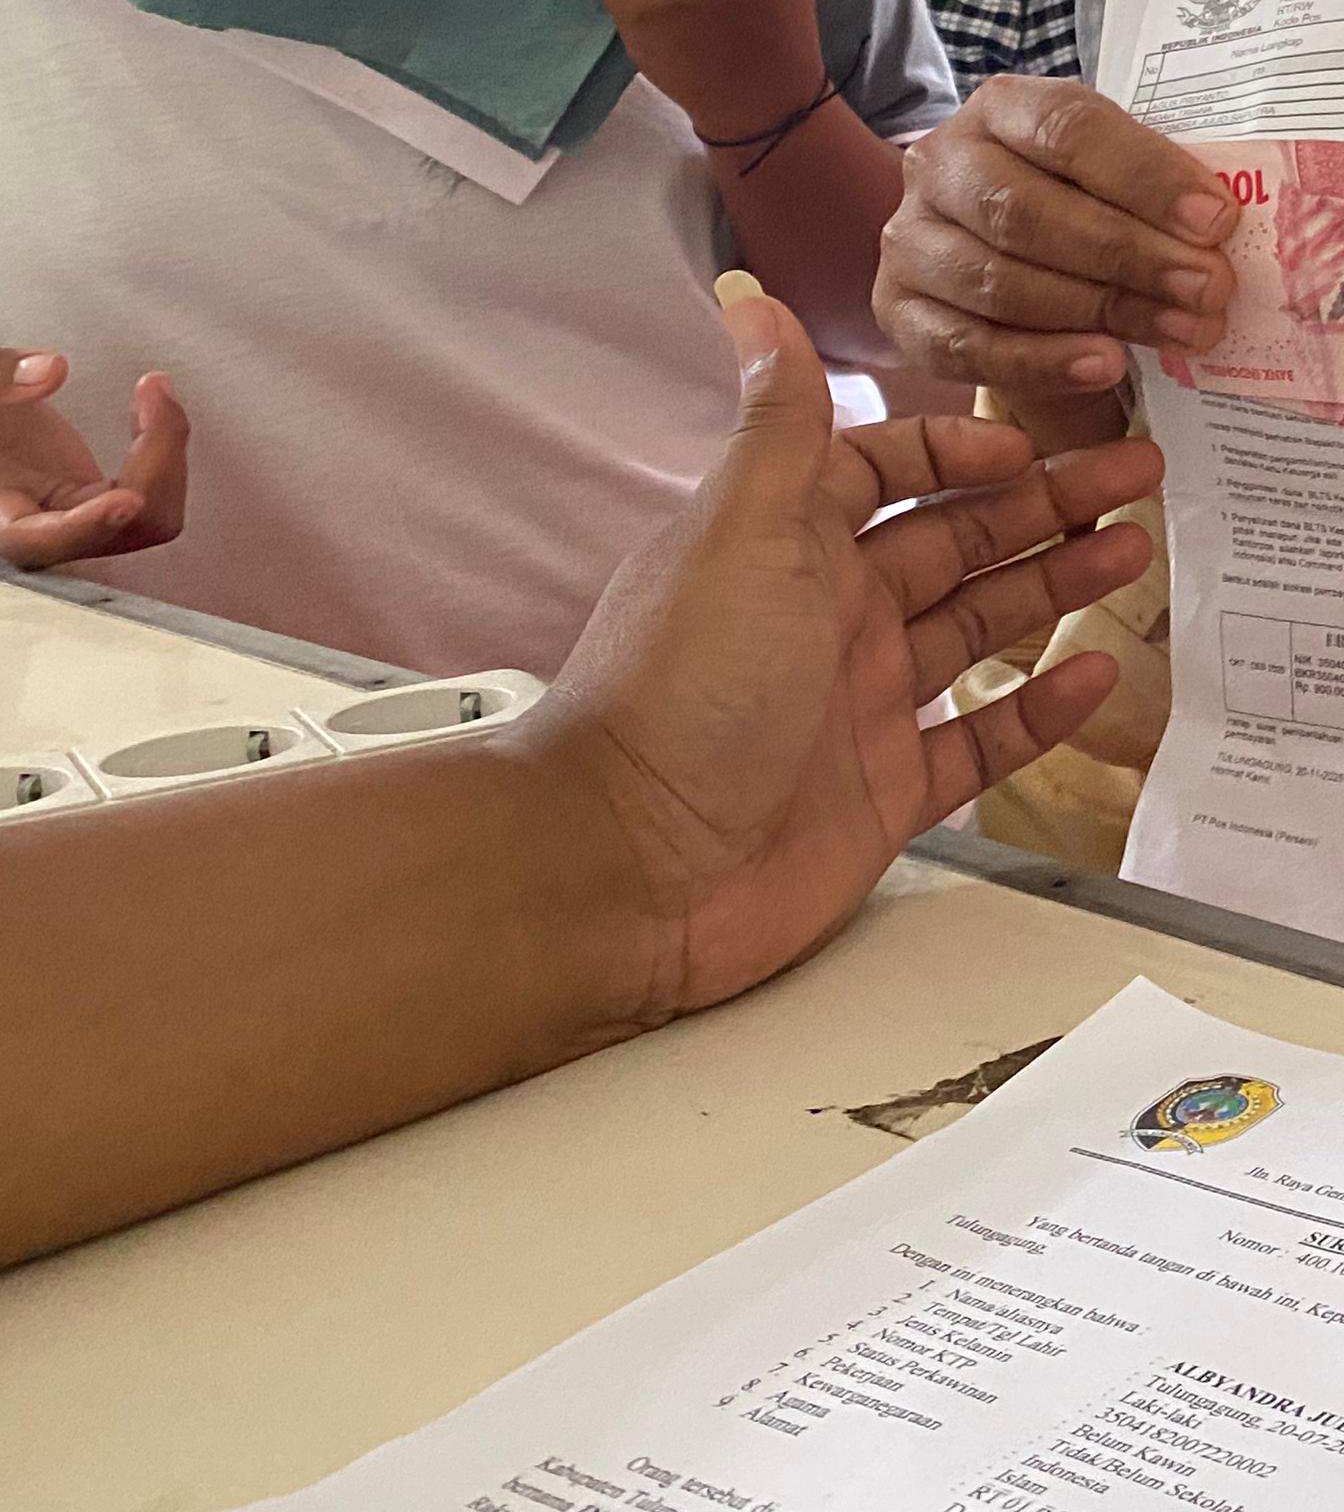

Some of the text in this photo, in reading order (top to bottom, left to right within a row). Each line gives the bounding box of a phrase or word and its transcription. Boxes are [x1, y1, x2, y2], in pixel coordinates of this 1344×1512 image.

[1274, 1173, 1314, 1195] Raya
[1025, 1215, 1068, 1238] Yang
[1068, 1228, 1138, 1259] bertanda
[1138, 1252, 1194, 1276] tangan
[1195, 1268, 1216, 1284] di
[1217, 1274, 1274, 1301] bawah
[1274, 1291, 1302, 1313] ini,
[1218, 1229, 1279, 1257] Nomor
[889, 1242, 1141, 1334] Dengan ini menerangkan bahwa
[871, 1326, 979, 1371] Nomor KTP
[896, 1314, 1013, 1365] Jenis Kelamin
[1014, 1333, 1069, 1359] Lahir
[819, 1355, 905, 1393] Pekerjaan
[849, 1341, 1000, 1407] Status Perkawinan
[1164, 1360, 1306, 1419] ALBYANDRA
[740, 1406, 810, 1438] Alamat
[1118, 1389, 1204, 1431] Laki-laki
[1046, 1438, 1168, 1492] Tidak/Belum
[1071, 1423, 1199, 1479] Belum Kawin
[1095, 1406, 1280, 1480] 3504182007220002
[994, 1468, 1052, 1497] Islam
[1020, 1453, 1113, 1496] Indonesia
